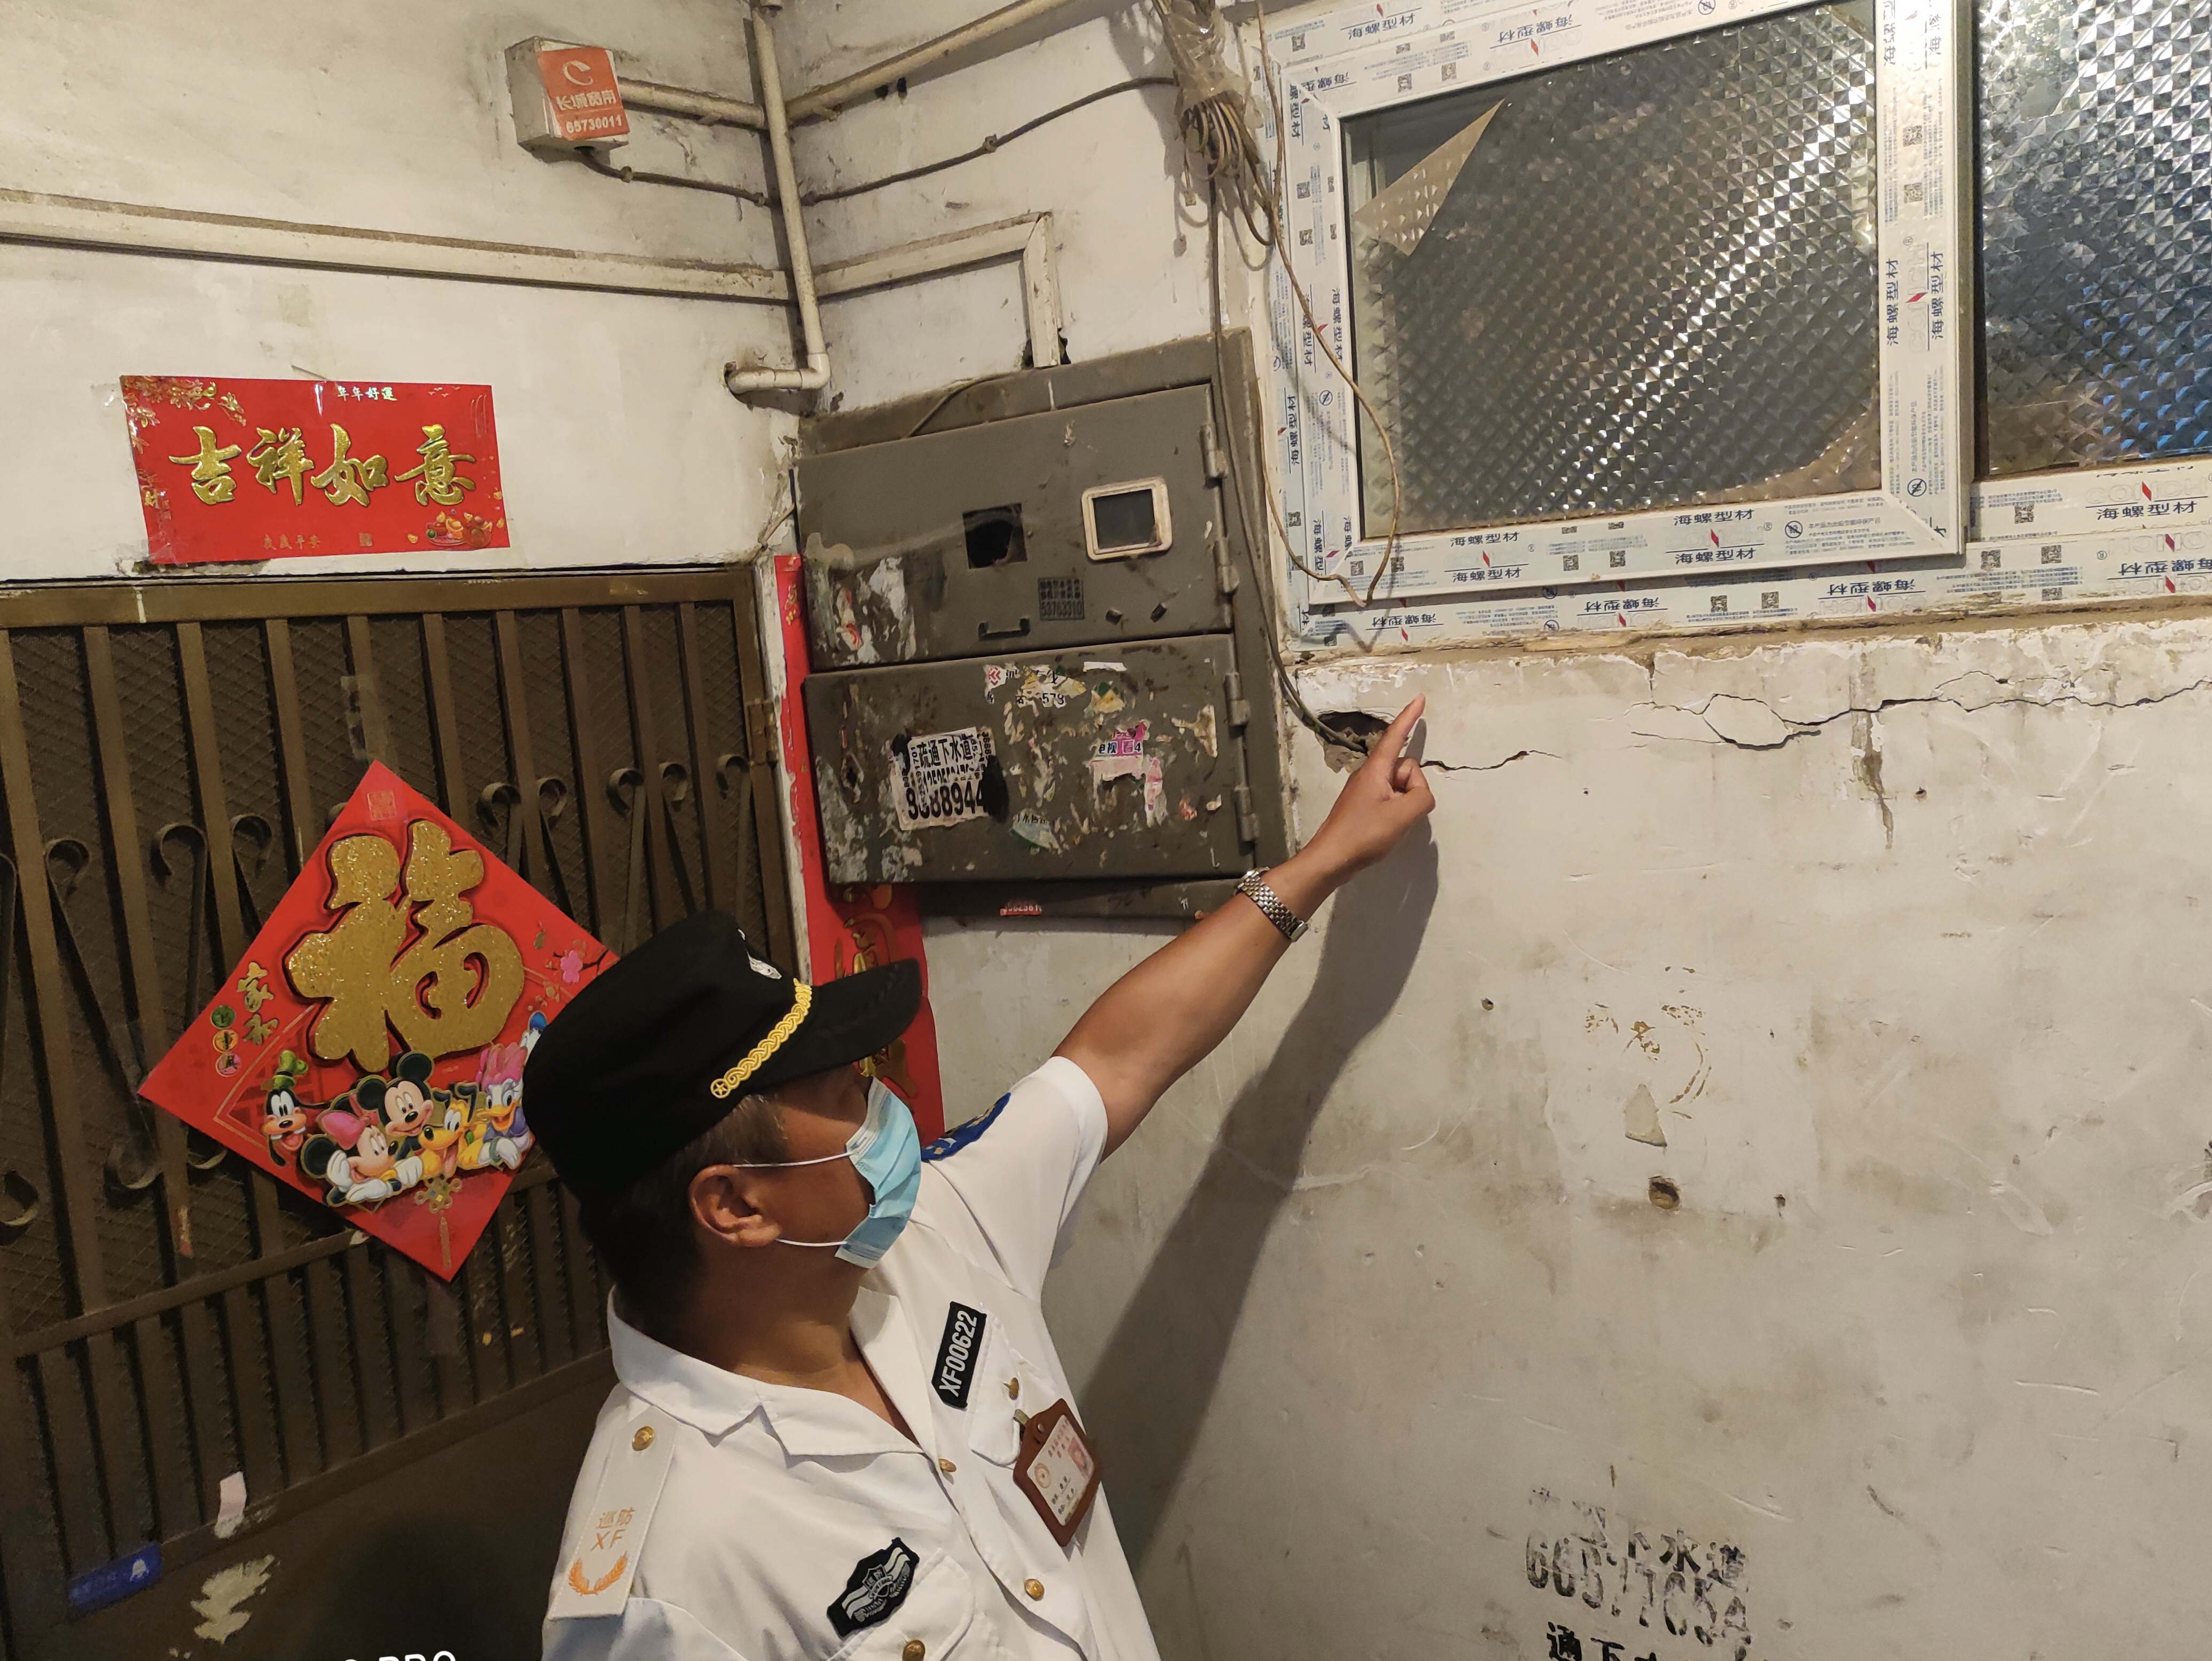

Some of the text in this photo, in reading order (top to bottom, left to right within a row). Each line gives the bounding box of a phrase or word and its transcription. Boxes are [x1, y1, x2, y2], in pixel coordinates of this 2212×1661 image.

[1348, 12, 1415, 40] 海螺型材
[1497, 13, 1574, 43] 海螺型材
[566, 115, 622, 134] 65730011
[1886, 258, 1899, 346] 海螺型材
[1931, 251, 1943, 339] 海螺型材
[1331, 288, 1344, 362] 海螺型材
[1288, 394, 1300, 465] 海螺型材
[168, 424, 477, 506] 吉祥如意
[1673, 508, 1755, 526] 海螺型材
[2097, 500, 2198, 520] 海螺型材
[1313, 519, 1325, 583] 海螺型
[1450, 531, 1520, 547] 海螺型材
[1675, 547, 1756, 565] 海螺型材
[1452, 567, 1522, 583] 海螺型材
[1827, 579, 1916, 596] 海螺型材
[1583, 597, 1660, 612] 海螺型材
[1372, 613, 1437, 628] 海螺型材
[917, 735, 973, 769] 疏通下水道
[286, 818, 525, 1073] 福
[237, 962, 278, 1046] 家和
[938, 1310, 978, 1398] XF00622
[596, 1506, 636, 1529] 巡防
[590, 1529, 626, 1552] XF
